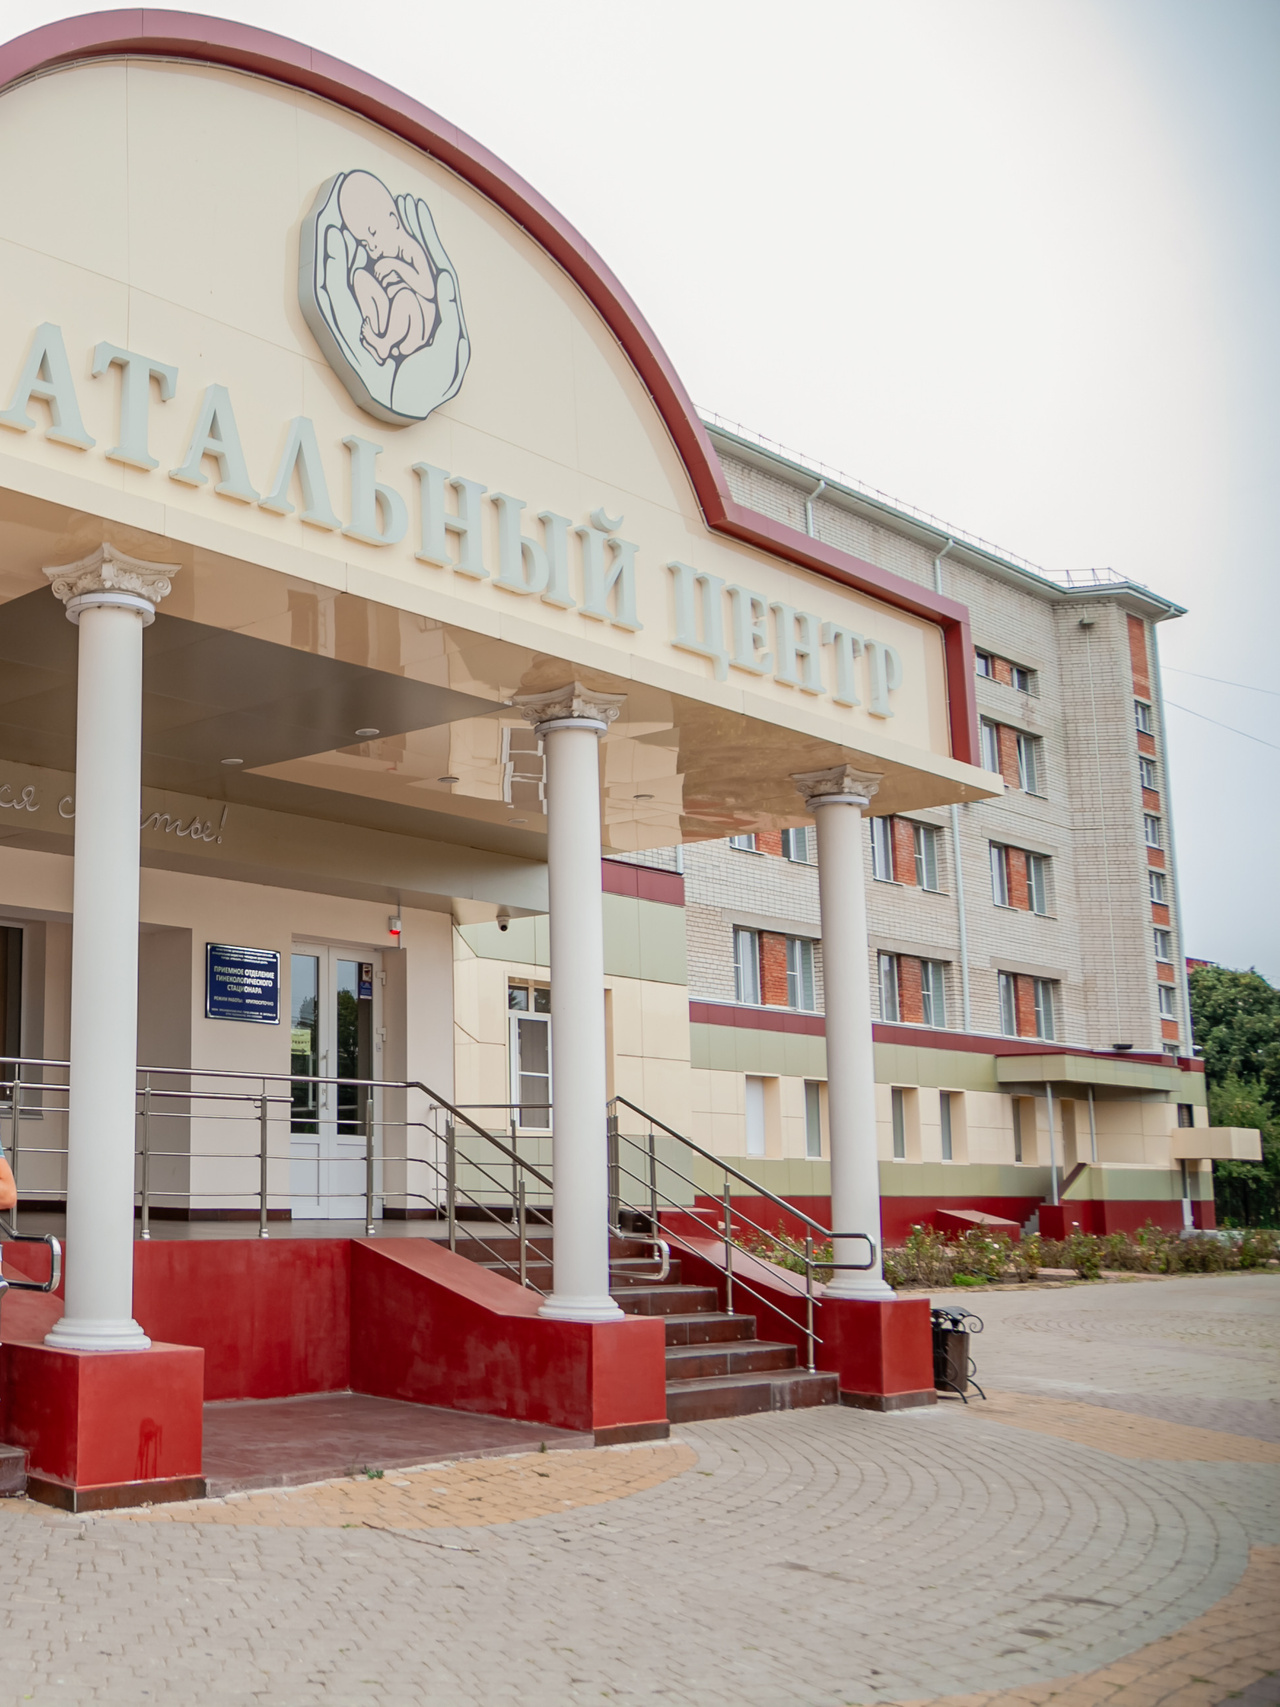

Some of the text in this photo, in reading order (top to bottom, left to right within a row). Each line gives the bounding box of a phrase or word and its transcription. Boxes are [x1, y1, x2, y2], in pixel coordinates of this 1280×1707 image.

[666, 560, 903, 719] ЦЕНТР
[214, 966, 274, 979] ПРИЕМНОЕ ОТДЕЛЕНИЕ
[216, 975, 273, 986] ГИНЕКОЛОГИЧЕСКОГО
[227, 985, 262, 994] СТАЦИОНАРА
